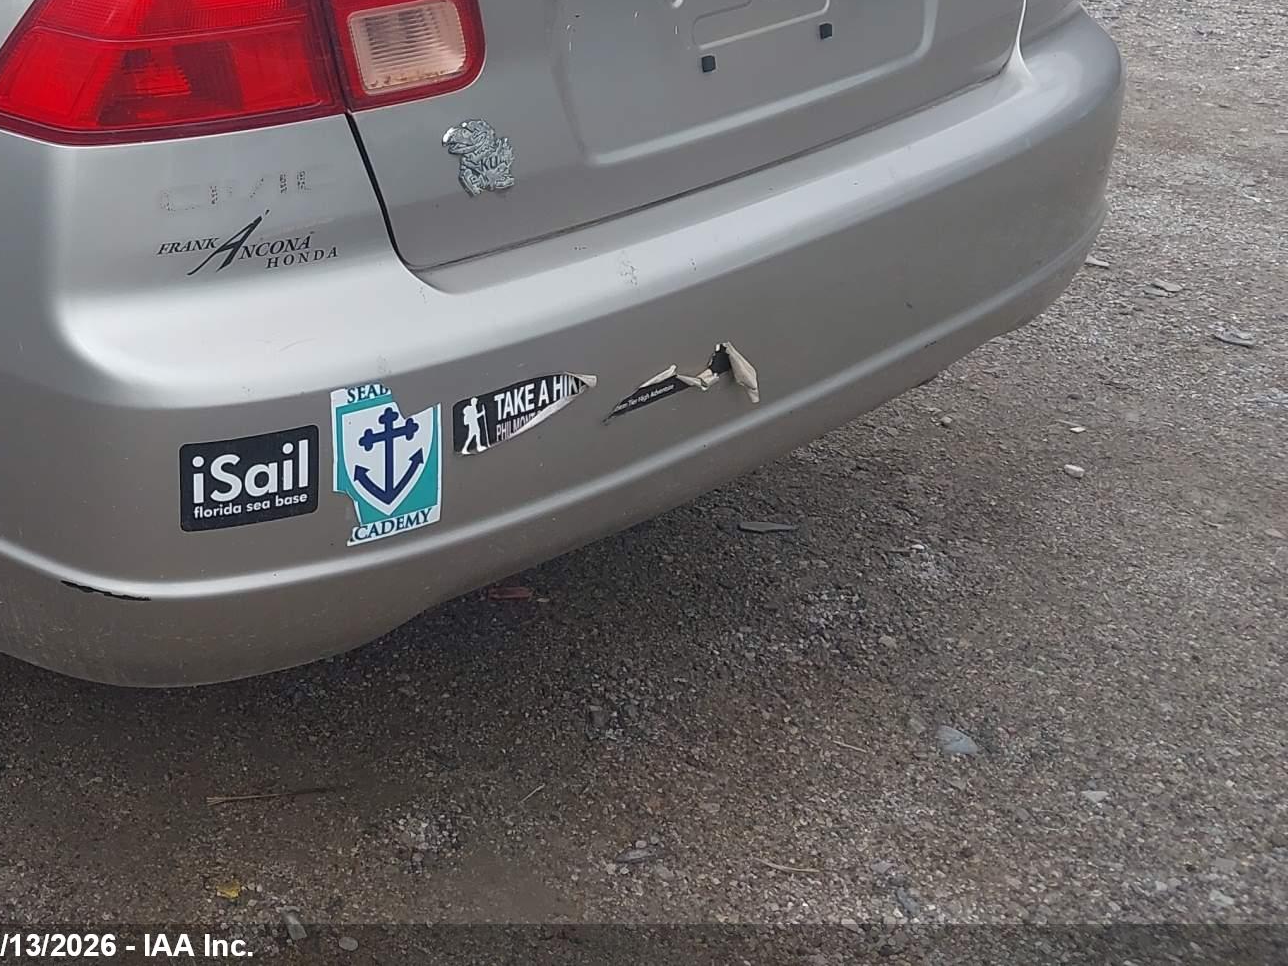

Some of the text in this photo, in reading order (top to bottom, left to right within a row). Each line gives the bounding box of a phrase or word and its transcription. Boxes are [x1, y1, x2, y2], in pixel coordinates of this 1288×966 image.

[157, 210, 314, 276] FRANK ANCONA
[266, 246, 338, 269] HONDA
[494, 383, 535, 421] TAKE
[538, 379, 549, 407] A
[192, 439, 310, 504] iSail
[194, 493, 308, 520] florida sea base
[348, 507, 432, 542] CADEMY
